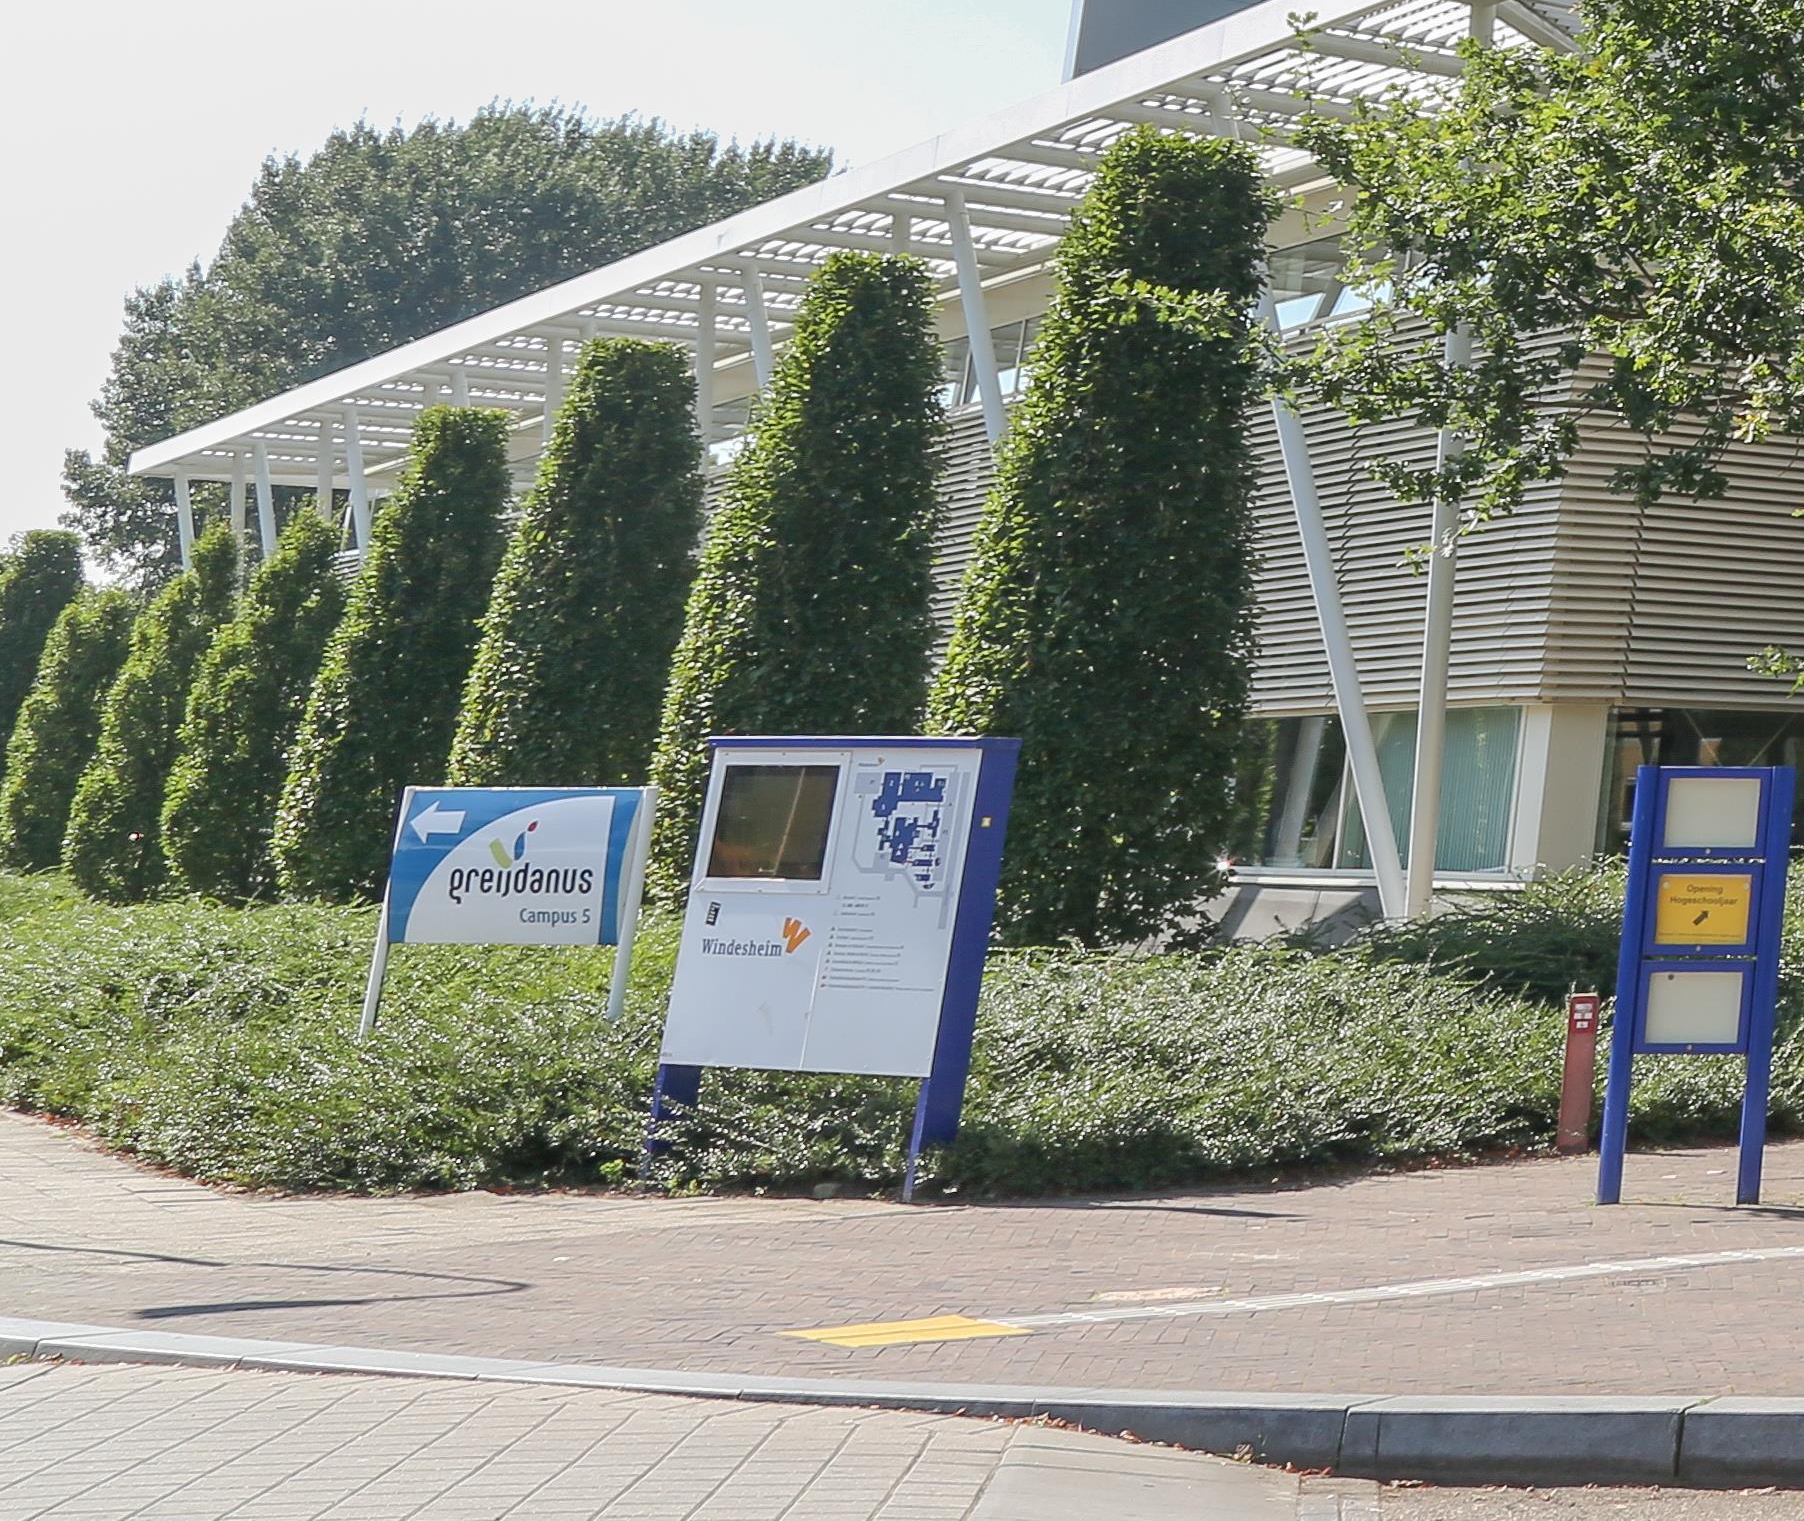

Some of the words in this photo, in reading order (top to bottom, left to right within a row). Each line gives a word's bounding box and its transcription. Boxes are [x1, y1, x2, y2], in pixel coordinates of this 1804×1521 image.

[449, 862, 594, 905] greijdanus
[1686, 884, 1724, 895] Opening
[1670, 896, 1738, 907] Hogeschooljaar
[519, 908, 577, 927] Campus
[582, 908, 591, 924] 5
[701, 938, 783, 957] Windesheim
